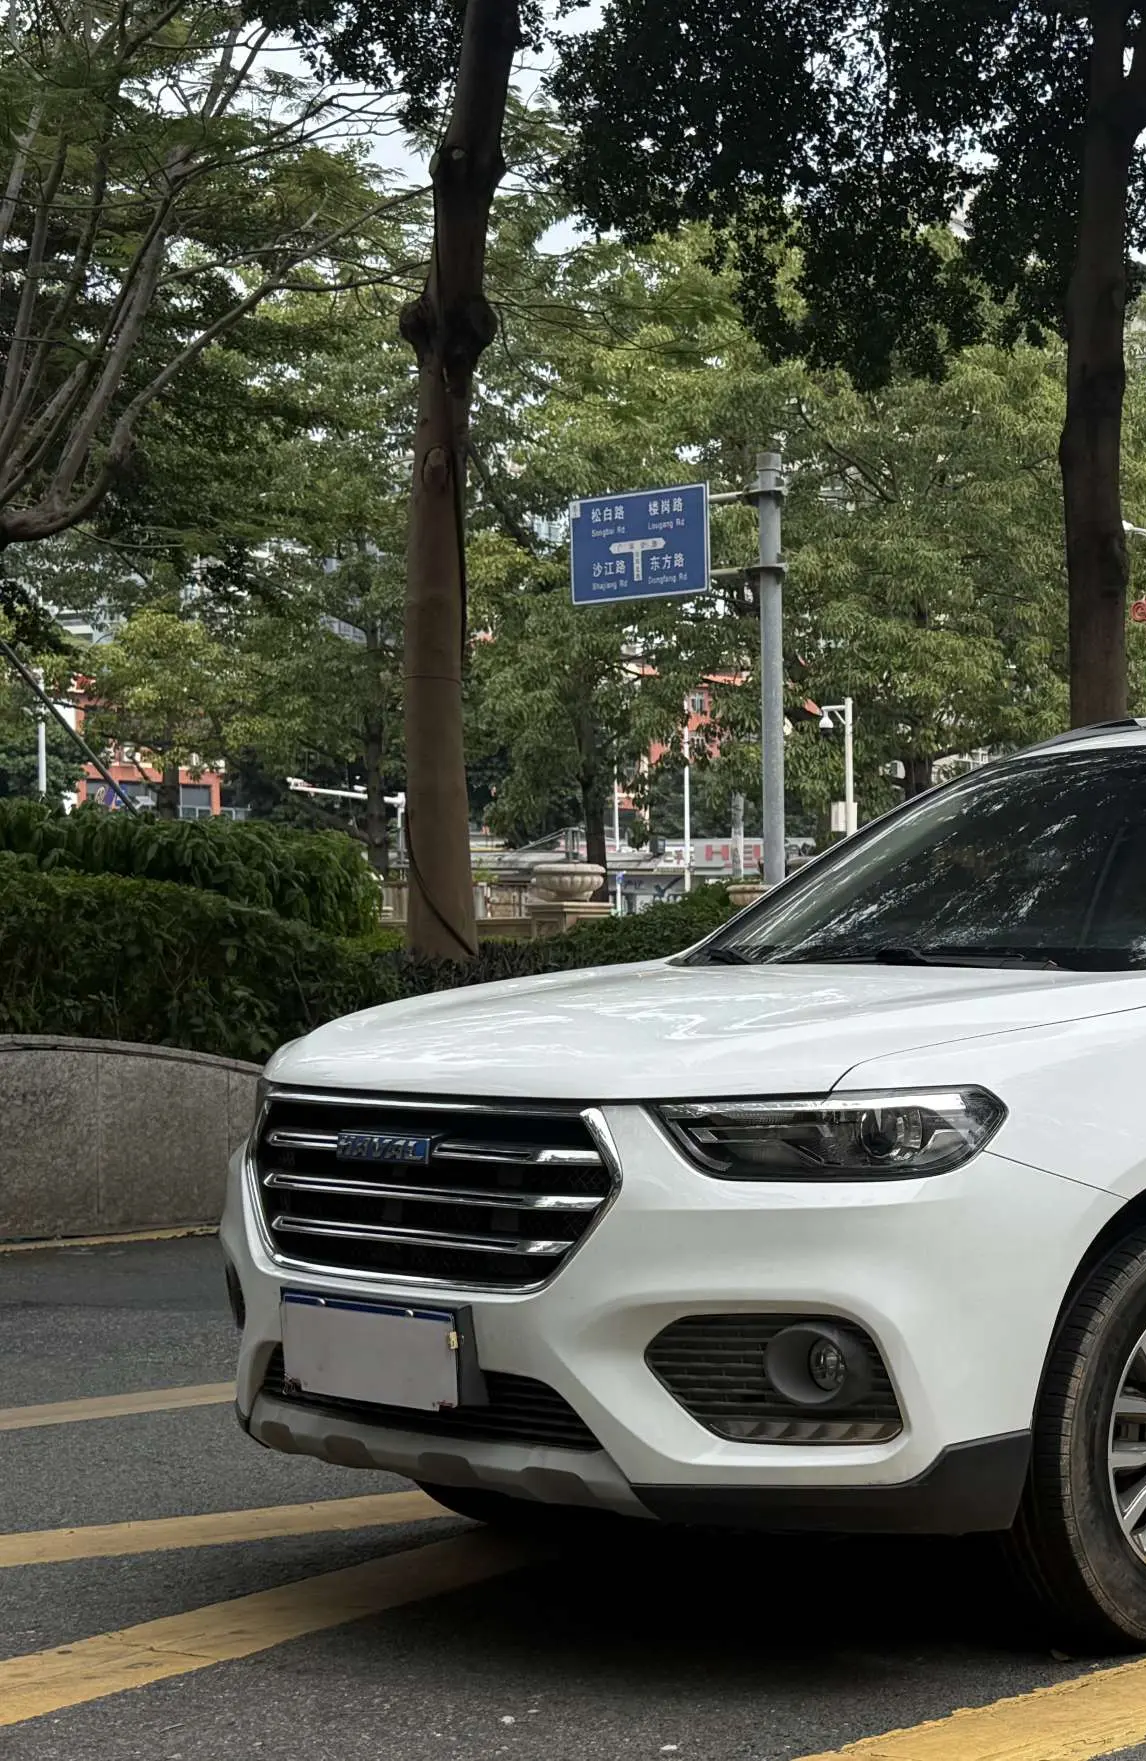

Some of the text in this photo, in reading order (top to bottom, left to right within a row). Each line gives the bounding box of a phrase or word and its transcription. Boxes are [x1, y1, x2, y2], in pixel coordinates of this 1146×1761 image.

[591, 505, 625, 523] 松白路
[648, 497, 683, 516] 楼岗路
[617, 525, 625, 534] Rd
[676, 517, 685, 526] Rd
[592, 560, 626, 578] 沙江路
[650, 552, 685, 571] 东方路
[619, 578, 628, 588] Rd
[679, 572, 688, 581] Rd
[337, 1135, 425, 1160] HAVAL
